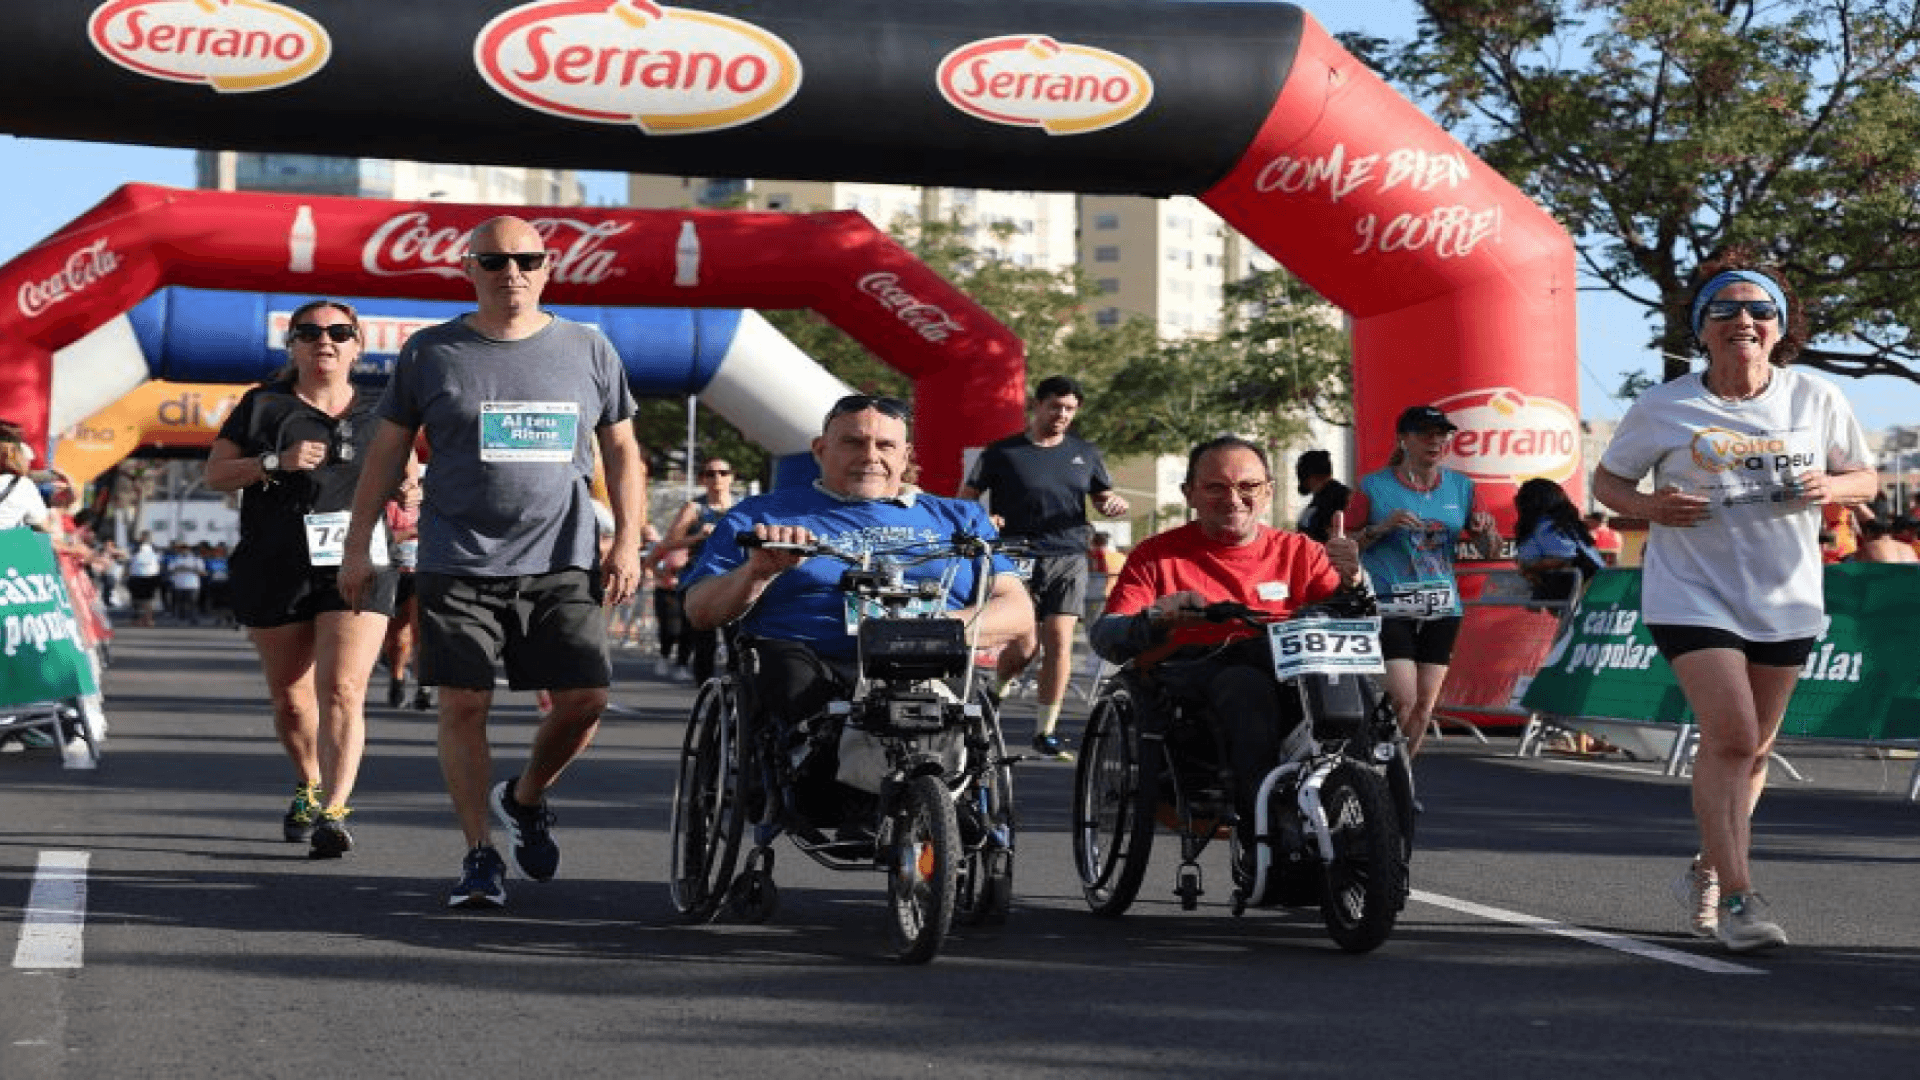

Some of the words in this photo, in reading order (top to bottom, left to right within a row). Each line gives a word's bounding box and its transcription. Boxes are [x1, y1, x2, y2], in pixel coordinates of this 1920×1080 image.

[117, 9, 305, 61] Serrano
[512, 25, 768, 94] Serrano
[963, 58, 1130, 103] Serrano
[1254, 143, 1381, 203] COME
[1376, 147, 1471, 195] BIEN
[1379, 204, 1504, 258] CORRE!
[1446, 428, 1574, 458] errano
[1711, 438, 1785, 458] Volta
[1744, 456, 1763, 470] a
[1583, 603, 1638, 635] caixa
[1279, 632, 1373, 655] 5873
[1565, 636, 1658, 676] popular
